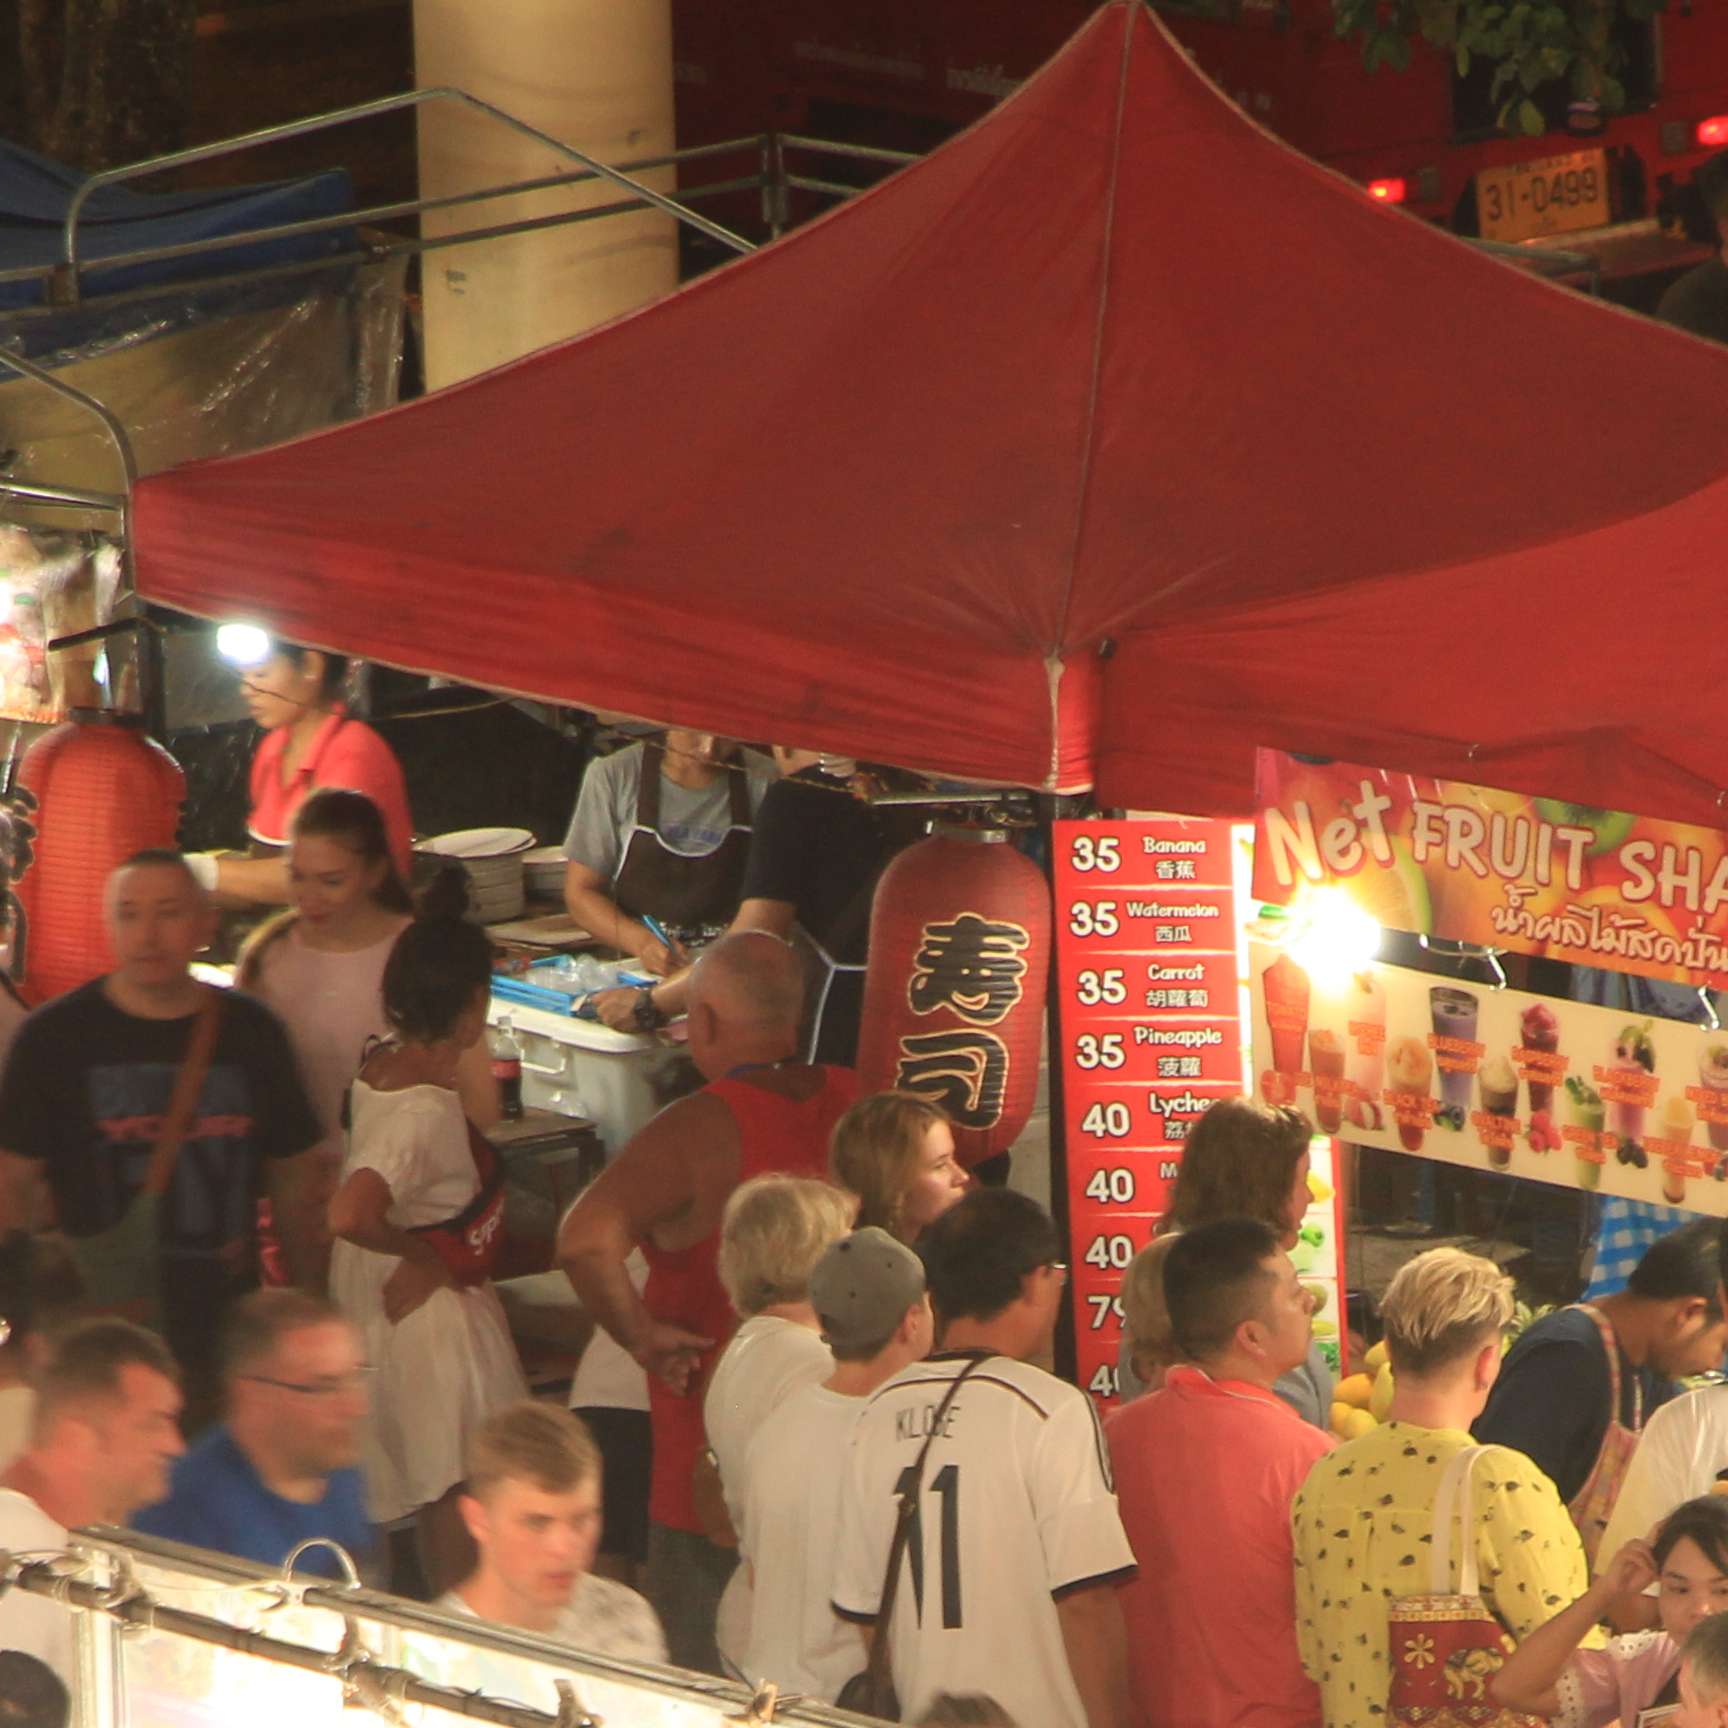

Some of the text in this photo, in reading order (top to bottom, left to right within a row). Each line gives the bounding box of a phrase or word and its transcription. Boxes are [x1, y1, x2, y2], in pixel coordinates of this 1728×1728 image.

[1071, 835, 1206, 873] 35 Banana
[1264, 779, 1392, 887] Net
[1410, 799, 1596, 892] FRUIT
[1069, 900, 1220, 937] 35 Watermelon
[1076, 963, 1205, 1006] 35 Carrot
[1074, 1026, 1223, 1070] 35 Pineapple
[1080, 1102, 1132, 1138] 40
[1085, 1168, 1135, 1203] 40
[1084, 1235, 1133, 1269] 40
